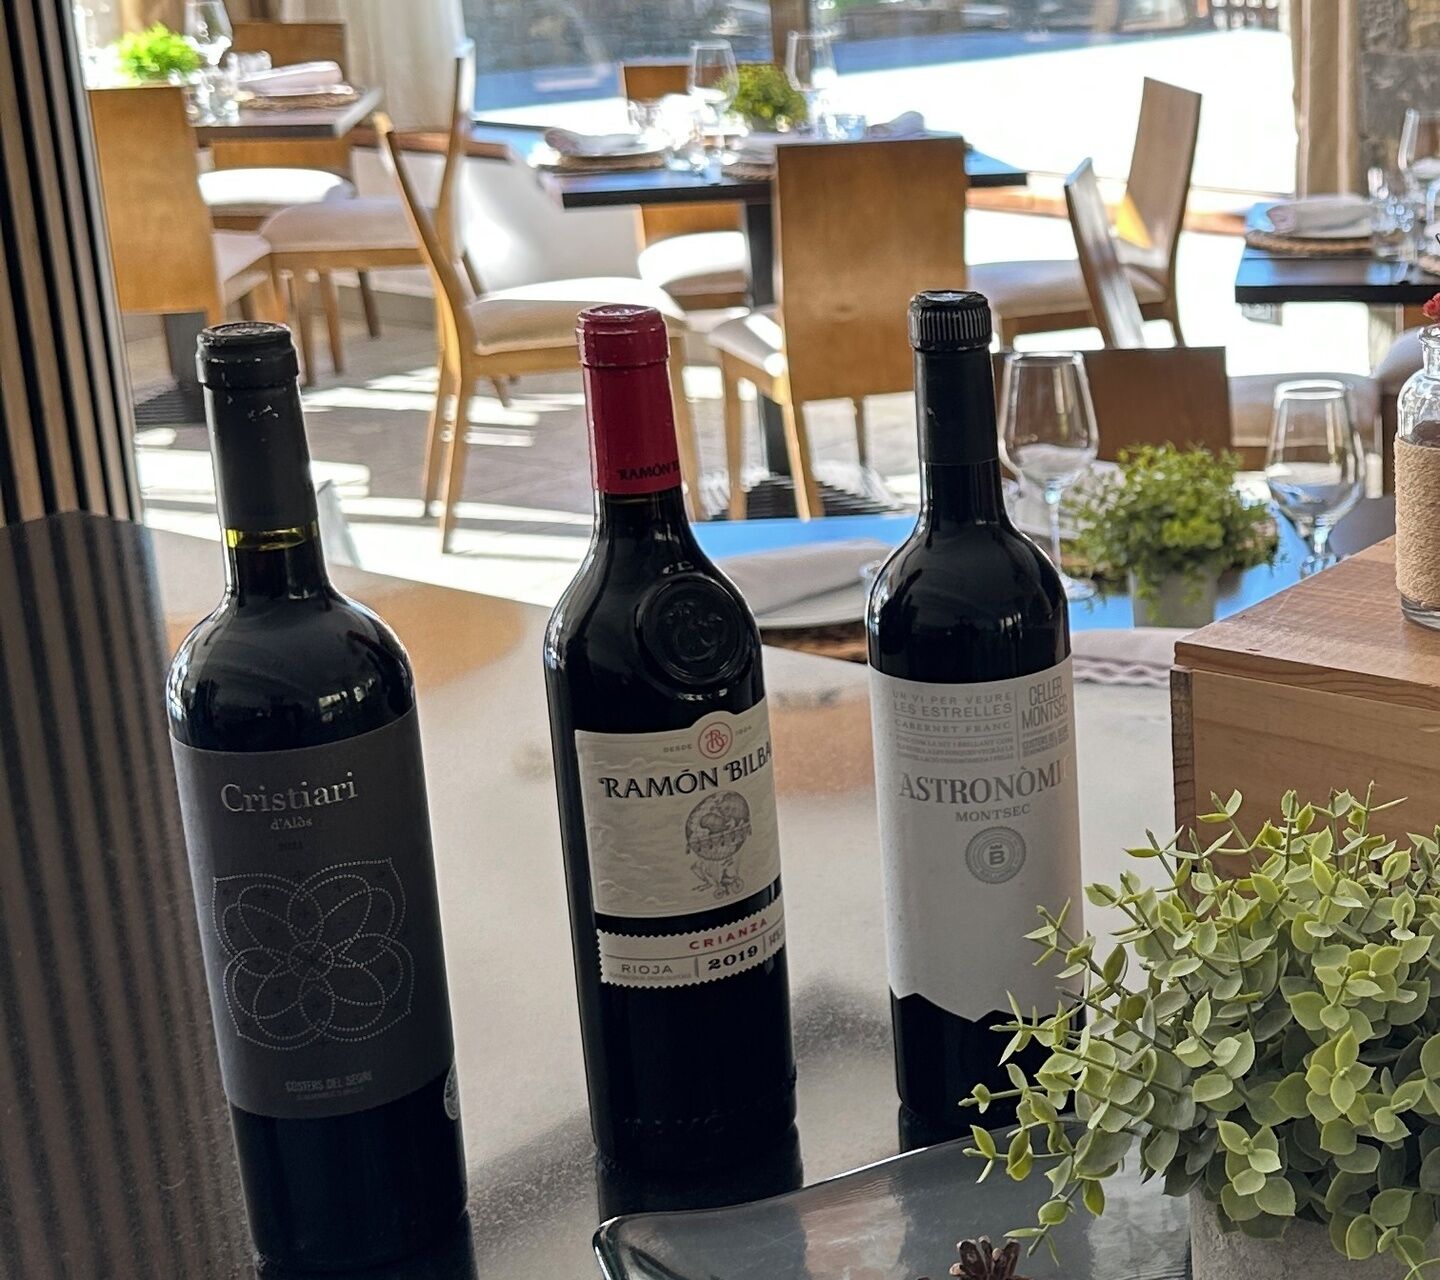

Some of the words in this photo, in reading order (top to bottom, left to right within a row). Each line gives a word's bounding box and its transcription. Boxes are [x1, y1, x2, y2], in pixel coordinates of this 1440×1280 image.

[931, 696, 958, 705] PER
[967, 692, 1012, 705] VEURE
[1029, 675, 1063, 706] CELLER
[894, 702, 917, 715] LES
[922, 702, 1013, 718] ESTRELLES
[895, 719, 958, 733] CABERNET
[966, 721, 1011, 733] FRANC
[220, 771, 359, 813] Cristiari
[598, 767, 720, 799] RAMÓN
[954, 803, 1032, 823] MONTSEC
[688, 918, 769, 950] CRIANZA
[620, 963, 673, 975] RIOJA
[707, 945, 759, 971] 2019
